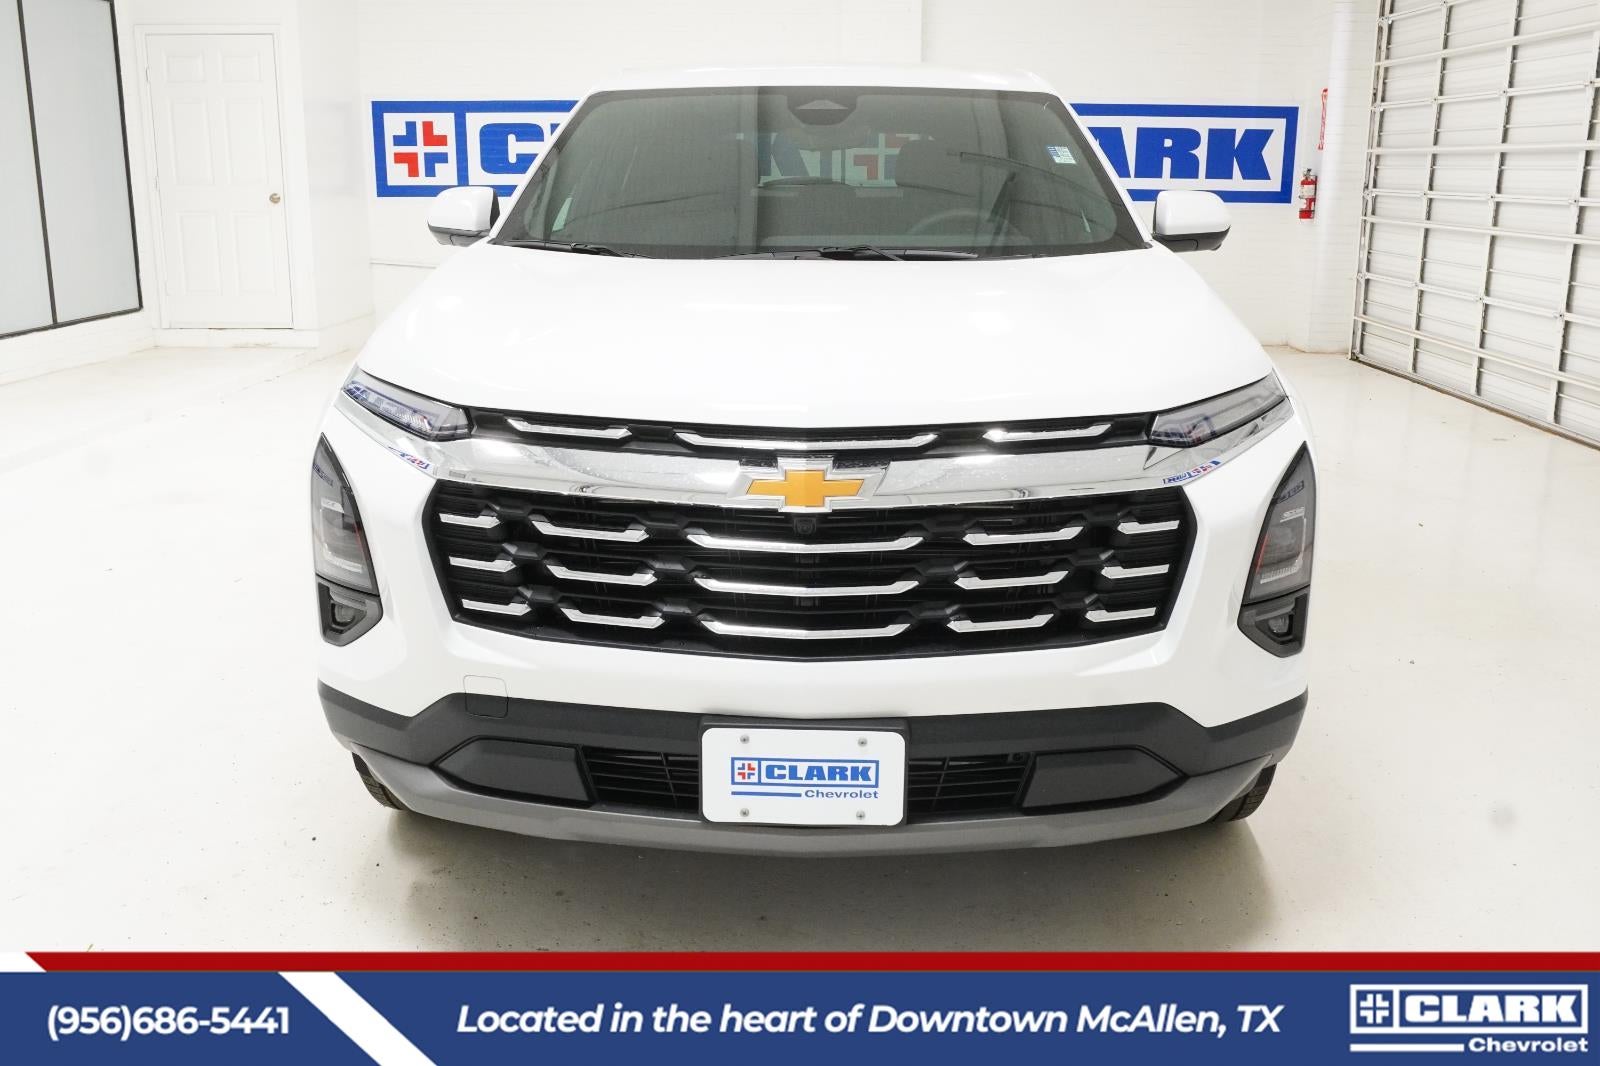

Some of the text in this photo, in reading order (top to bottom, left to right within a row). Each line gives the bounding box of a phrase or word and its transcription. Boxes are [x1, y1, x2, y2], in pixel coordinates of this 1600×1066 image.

[1086, 126, 1274, 180] ARK
[765, 764, 872, 782] CLARK
[804, 789, 879, 799] Chevrolet
